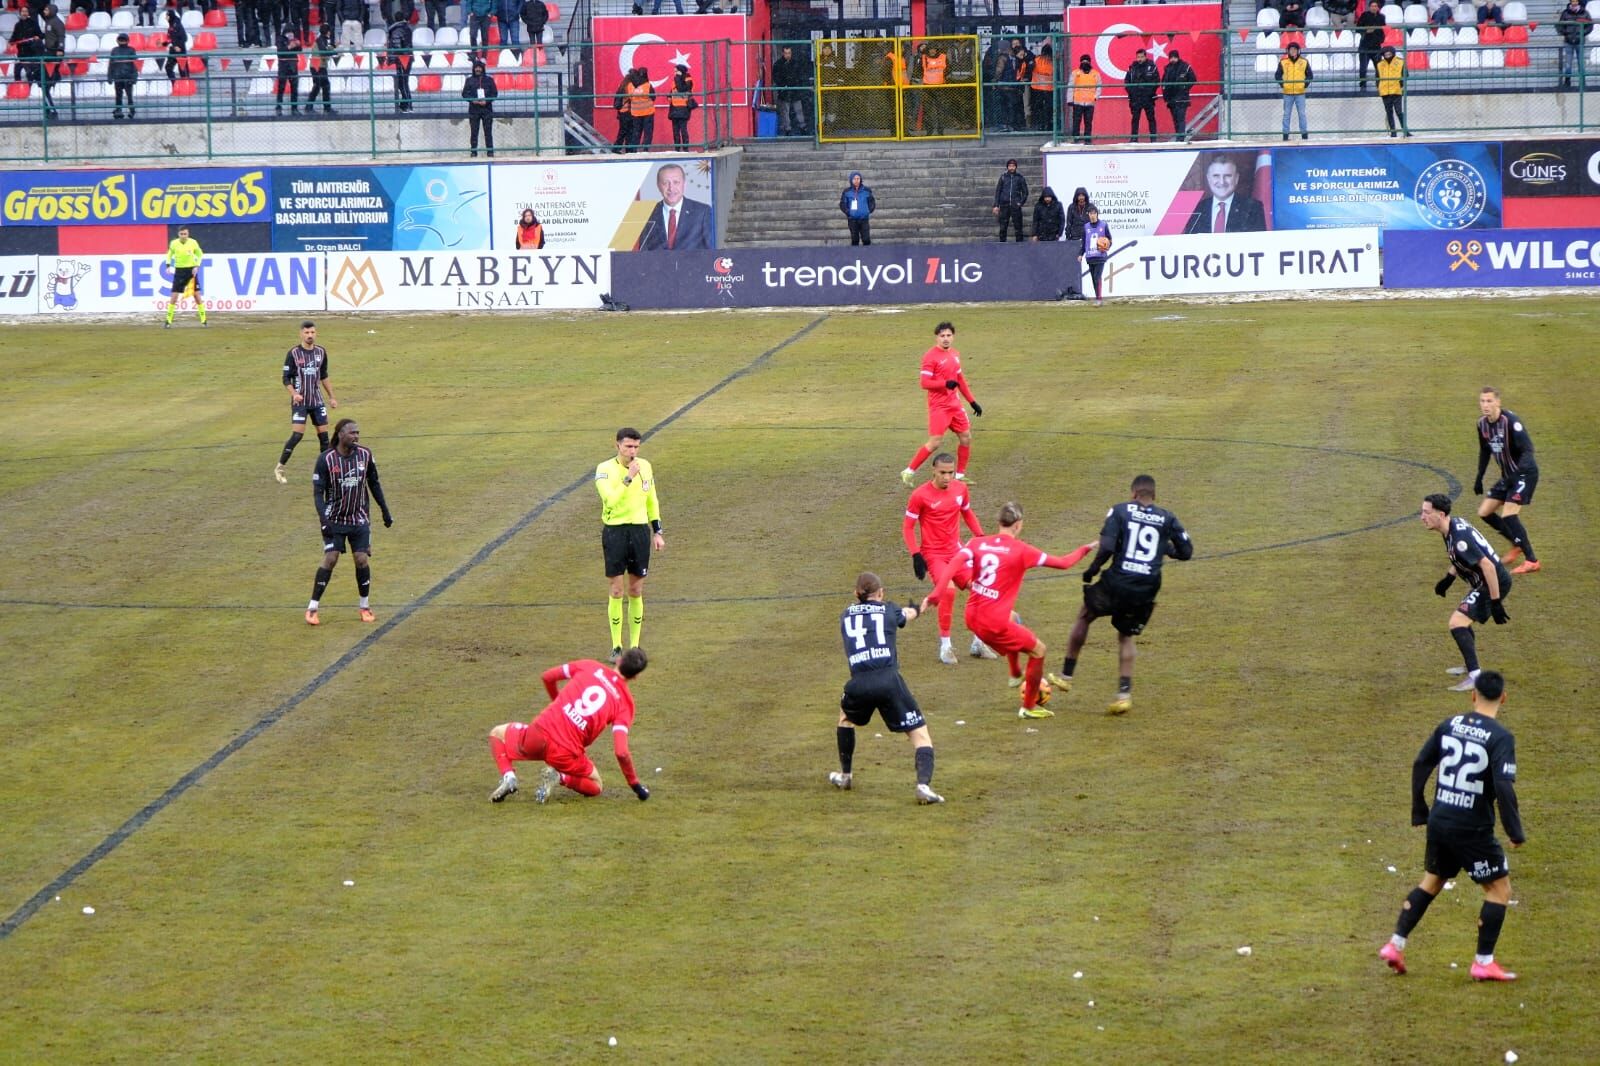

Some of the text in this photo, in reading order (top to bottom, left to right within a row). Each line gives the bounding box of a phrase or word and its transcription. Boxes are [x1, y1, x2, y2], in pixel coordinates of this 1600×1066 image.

[1306, 167, 1386, 177] TÜM ANTRENÖR
[1509, 160, 1567, 181] GÜNEŞ
[291, 179, 370, 194] TÜM ANTRENÖR
[1293, 181, 1399, 191] VE SPORCULARIMIZA
[280, 197, 383, 209] VE SPORCULARIMIZA
[516, 201, 533, 209] TÜM
[535, 201, 576, 209] ANTRENÖR
[1289, 193, 1405, 204] BAŞARILAR DİLİYORUM
[275, 210, 388, 225] BAŞARILAR DİLİYORUM
[552, 217, 589, 225] DİLİYORUM
[398, 254, 602, 287] MABEYN
[1139, 252, 1265, 280] TURGUT
[227, 257, 317, 296] VAN
[705, 274, 744, 284] trendyol
[762, 258, 912, 291] trendyol
[1565, 271, 1595, 279] SINCE
[216, 300, 232, 310] 00
[457, 287, 544, 310] İNŞAAT
[320, 406, 327, 417] 3
[1516, 481, 1526, 493] 7
[1131, 510, 1165, 523] REFORM
[1125, 521, 1160, 562] 19
[978, 553, 1000, 587] 8
[848, 604, 886, 613] REFORM
[844, 613, 887, 650] 41
[574, 685, 607, 717] 9
[562, 702, 588, 731] ARDA
[1452, 723, 1492, 741] REFORM
[1438, 735, 1489, 795] 22
